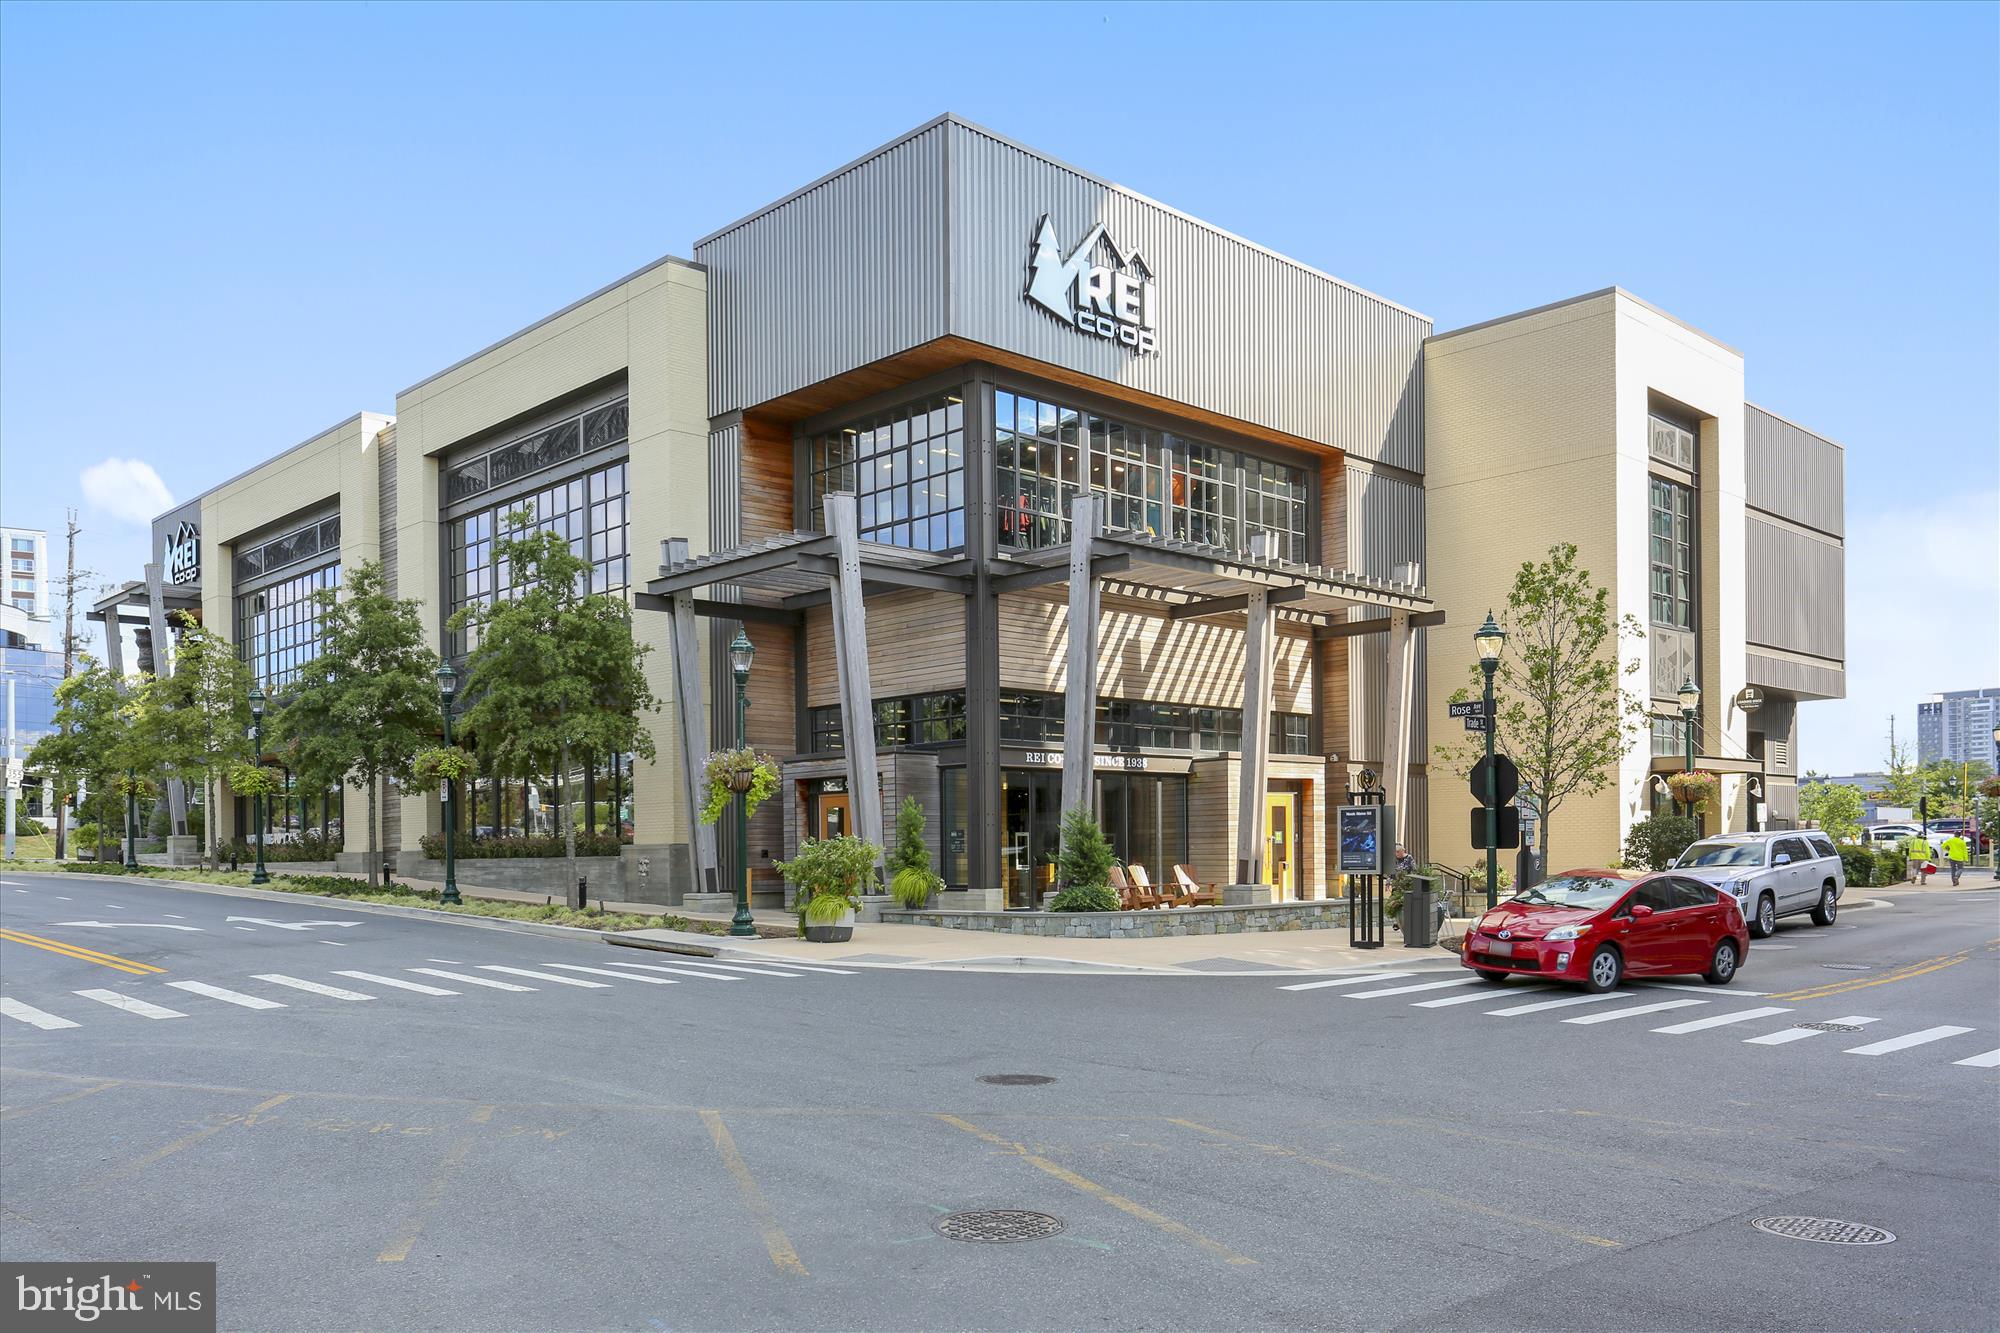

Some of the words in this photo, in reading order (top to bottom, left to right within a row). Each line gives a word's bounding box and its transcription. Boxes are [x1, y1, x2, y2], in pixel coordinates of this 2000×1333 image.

[1077, 260, 1156, 330] REI
[1451, 705, 1471, 716] Rose
[1025, 751, 1045, 763] REI
[1094, 755, 1125, 767] SINCE
[1126, 757, 1148, 769] 1938
